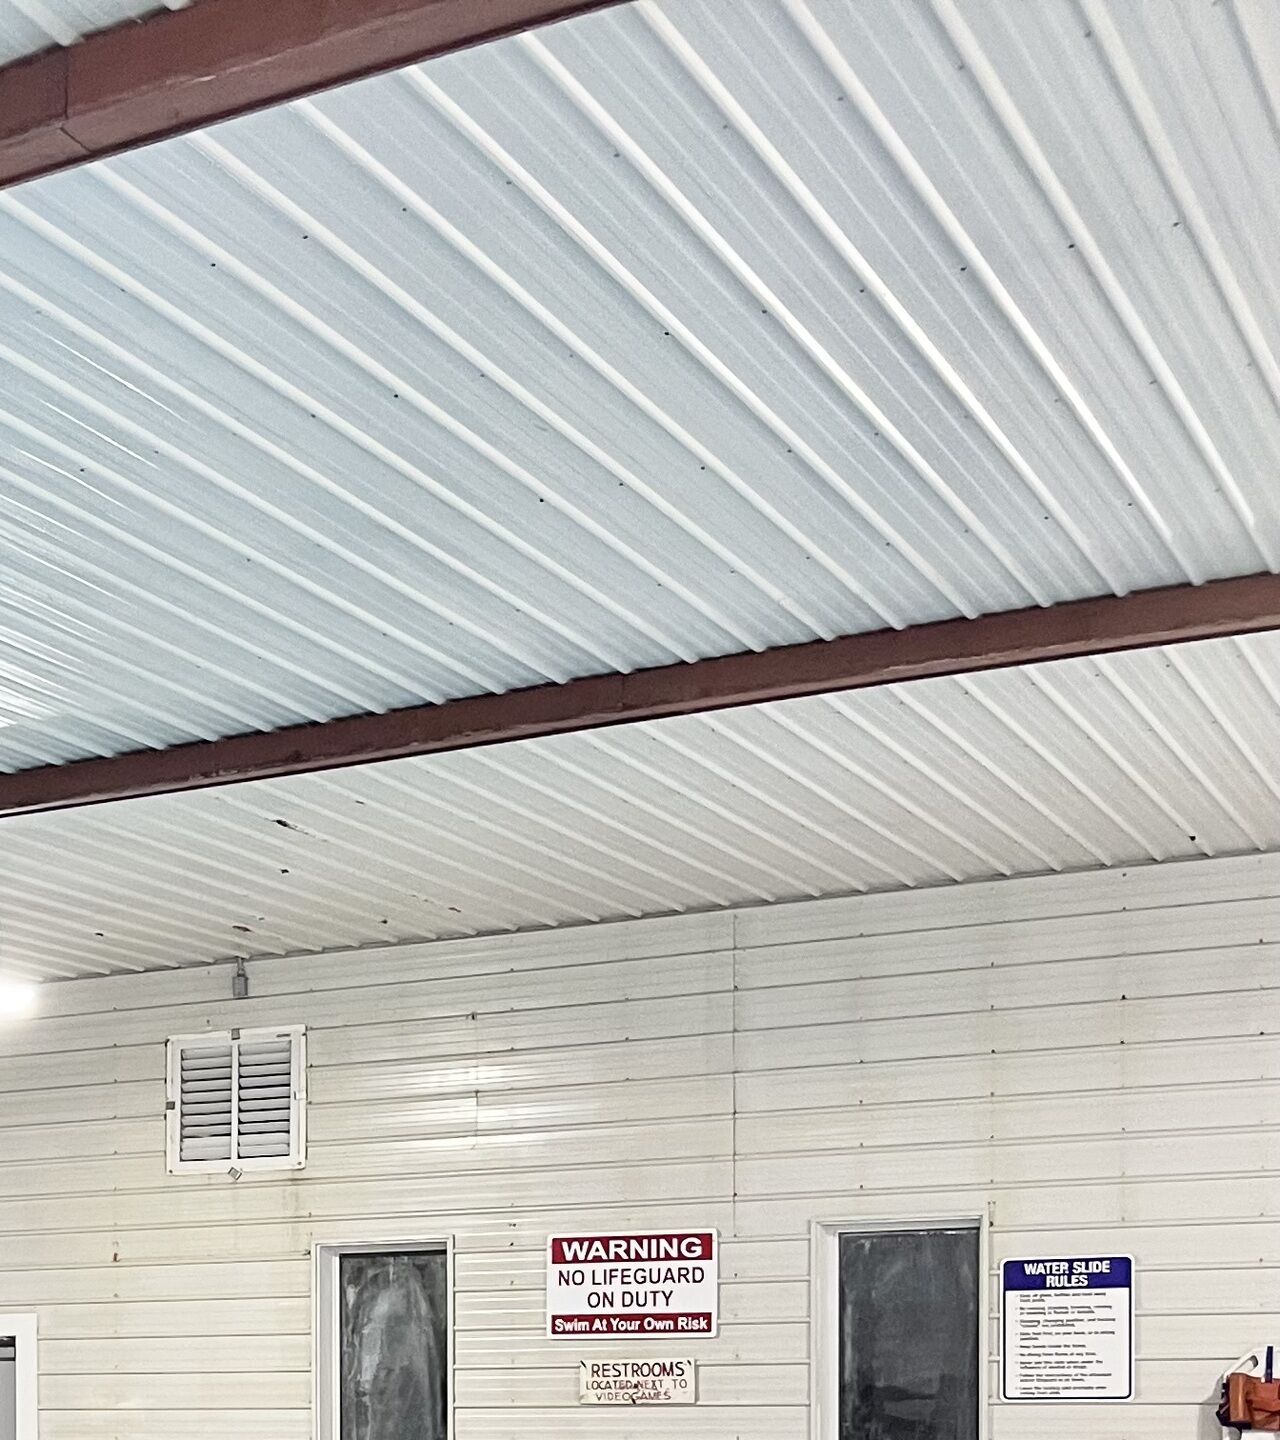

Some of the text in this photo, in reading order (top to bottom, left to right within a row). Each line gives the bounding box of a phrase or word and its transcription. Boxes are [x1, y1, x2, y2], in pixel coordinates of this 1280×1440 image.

[562, 1237, 703, 1261] WARNING
[1024, 1260, 1110, 1275] WATER SLIDE
[558, 1266, 705, 1287] NO LIFEGUARD
[1046, 1275, 1089, 1288] RULES
[587, 1290, 674, 1309] ON DUTY
[554, 1315, 709, 1332] Swim At Your Own Risk
[591, 1361, 685, 1378] RESTROOMS
[586, 1378, 688, 1391] LOCATED NEXT TO
